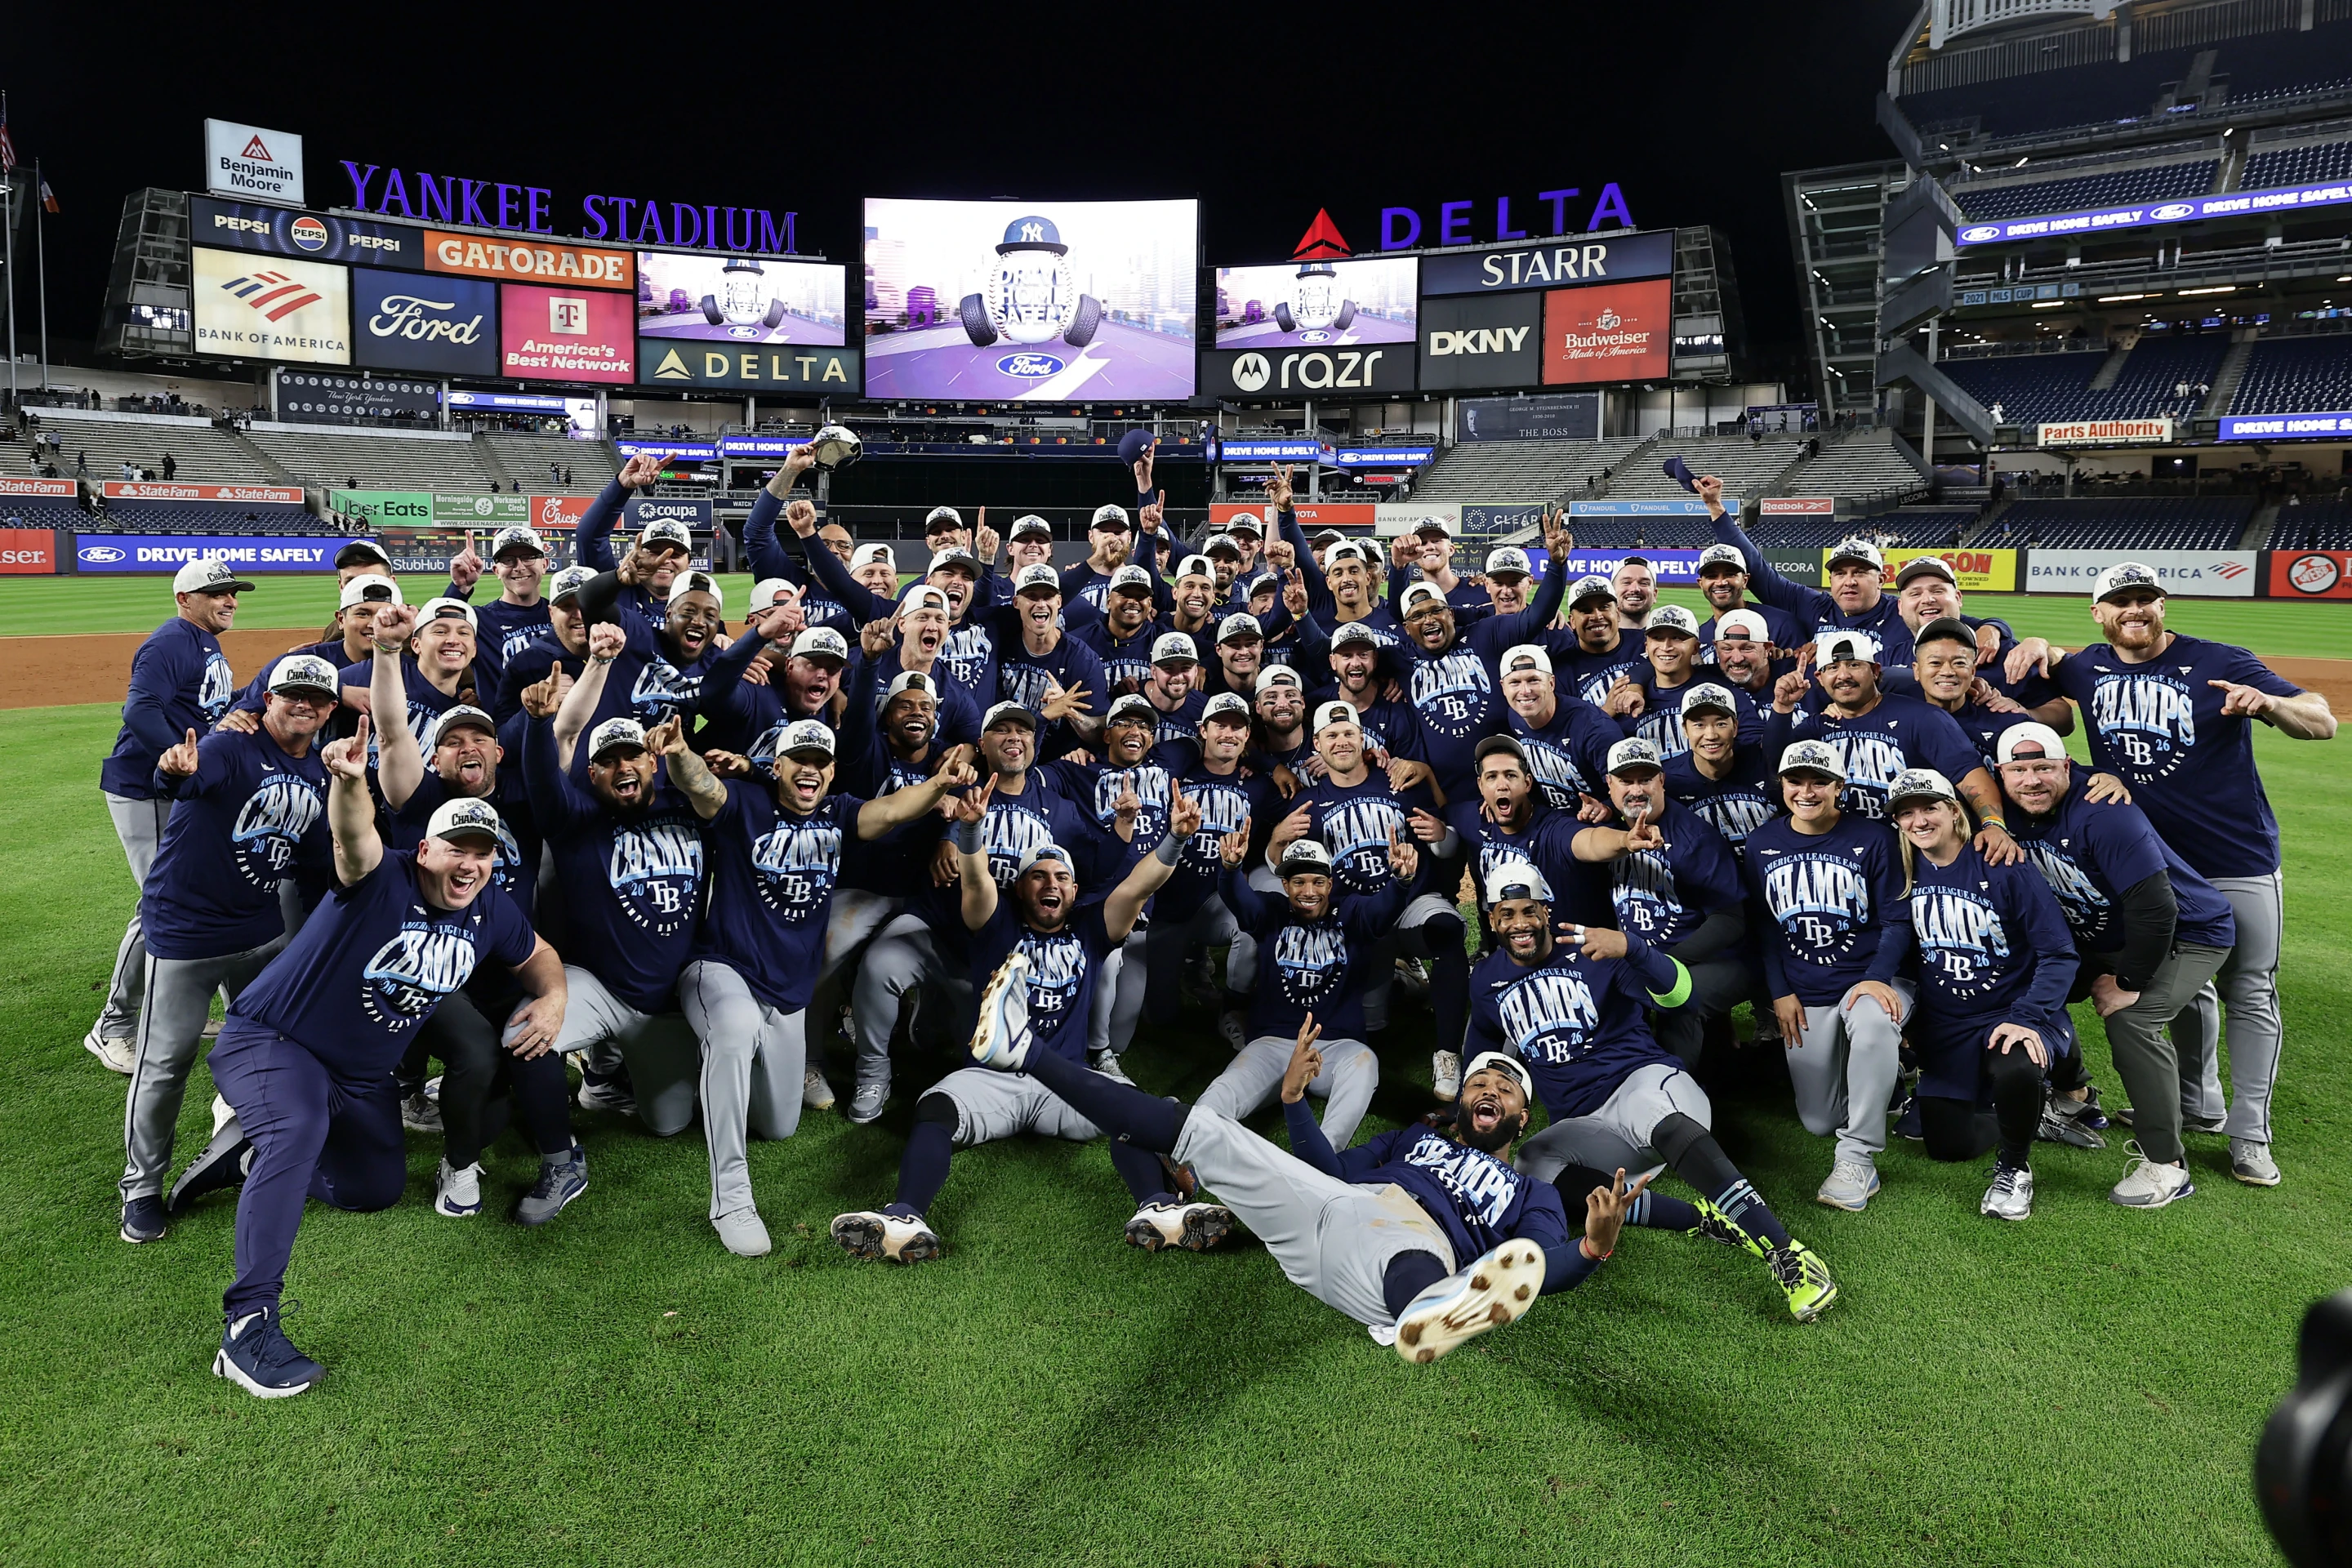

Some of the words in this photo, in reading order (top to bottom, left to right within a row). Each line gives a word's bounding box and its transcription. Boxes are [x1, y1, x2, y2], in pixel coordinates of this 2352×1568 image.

[220, 157, 293, 180] Benjamin
[230, 173, 282, 193] Moore
[340, 160, 552, 234] YANKEE
[583, 194, 798, 254] STADIUM
[2203, 198, 2250, 214] DRIVE
[2252, 193, 2298, 207] HOME
[1381, 182, 1633, 252] DELTA
[2007, 221, 2048, 236] DRIVE
[2051, 217, 2089, 231] HOME
[2091, 211, 2143, 226] SAFELY
[214, 215, 270, 234] PEPSI
[294, 228, 325, 240] PEPSI
[349, 234, 400, 252] PEPSI
[438, 240, 623, 281] GATORADE
[1481, 244, 1607, 287] STARR
[999, 267, 1064, 285] DRIVE
[1966, 293, 1984, 303] 2021
[1993, 292, 2009, 301] MLS
[2016, 289, 2033, 299] CUP
[368, 295, 483, 345] Ford
[996, 306, 1068, 325] SAFELY
[198, 327, 244, 342] BANK
[249, 332, 271, 344] OF
[274, 336, 345, 351] AMERICA
[1429, 326, 1530, 356] DKNY
[1565, 330, 1650, 348] Budweiser
[521, 340, 615, 358] America's
[1563, 348, 1594, 359] Made
[1595, 347, 1607, 359] of
[1604, 345, 1647, 357] America
[506, 353, 550, 368] Best
[552, 354, 630, 372] Network
[706, 352, 847, 381] DELTA
[1009, 355, 1053, 376] Ford
[1281, 350, 1383, 389] razr
[327, 390, 344, 399] New
[344, 392, 363, 403] York
[363, 393, 394, 404] Yankees
[1519, 429, 1539, 437] THE
[1543, 428, 1568, 436] BOSS
[2045, 425, 2084, 439] Parts
[2089, 421, 2164, 437] Authority
[2233, 421, 2284, 434] DRIVE
[2287, 419, 2336, 432] HOME
[686, 448, 715, 457] SAFELY
[725, 442, 755, 451] DRIVE
[757, 443, 783, 452] HOME
[1224, 448, 1252, 456] DRIVE
[1282, 447, 1315, 455] SAFELY
[436, 495, 473, 505] Morningside
[493, 496, 526, 505] Workmen's
[1763, 501, 1804, 511] Reebok
[1900, 491, 1929, 504] LEGORA
[336, 500, 380, 515] Uber
[384, 501, 428, 516] Eats
[508, 504, 525, 512] Circle
[542, 501, 582, 524] Chick-
[657, 506, 697, 519] coupa
[1494, 514, 1539, 525] CLEAR
[84, 547, 119, 560] Ford
[137, 547, 198, 562] DRIVE
[203, 548, 257, 561] HOME
[261, 548, 324, 563] SAFELY
[394, 559, 445, 570] StubHub
[1651, 560, 1699, 574] AFELY
[2032, 566, 2080, 576] BANK
[2160, 568, 2203, 578] RICA
[2109, 575, 2154, 588] CHAMPIONS
[287, 669, 332, 687] CHAMPIONS
[1411, 653, 1492, 704] CHAMPS
[2168, 678, 2190, 693] EAST
[1438, 696, 1470, 722] TB
[1468, 692, 1478, 704] 26
[1690, 694, 1726, 706] CHAMPIONS
[2091, 680, 2195, 746] CHAMPS
[1617, 751, 1655, 764] CHAMPIONS
[2118, 733, 2154, 766] TB
[2156, 738, 2170, 751] 26
[1788, 751, 1829, 768] CHAMPIONS
[452, 811, 497, 826] CHAMPIONS
[1323, 803, 1406, 867] CHAMPS
[611, 825, 702, 888] CHAMPS
[751, 829, 844, 876] CHAMPS
[1356, 852, 1387, 878] TB
[1764, 853, 1804, 873] AMERICAN
[1806, 853, 1838, 863] LEAGUE
[1841, 857, 1861, 871] EAST
[648, 880, 681, 913] TB
[781, 874, 812, 902] TB
[1764, 862, 1868, 925] CHAMPS
[1787, 920, 1796, 933] 20
[1797, 917, 1835, 948] TB
[1837, 919, 1850, 931] 26
[1275, 925, 1348, 970] CHAMPS
[1528, 969, 1561, 980] LEAGUE
[1563, 969, 1583, 979] EAST
[1499, 976, 1599, 1054] CHAMPS
[1537, 1035, 1573, 1062] TB
[1571, 1031, 1583, 1045] 26
[1405, 1139, 1515, 1227] CHAMPS
